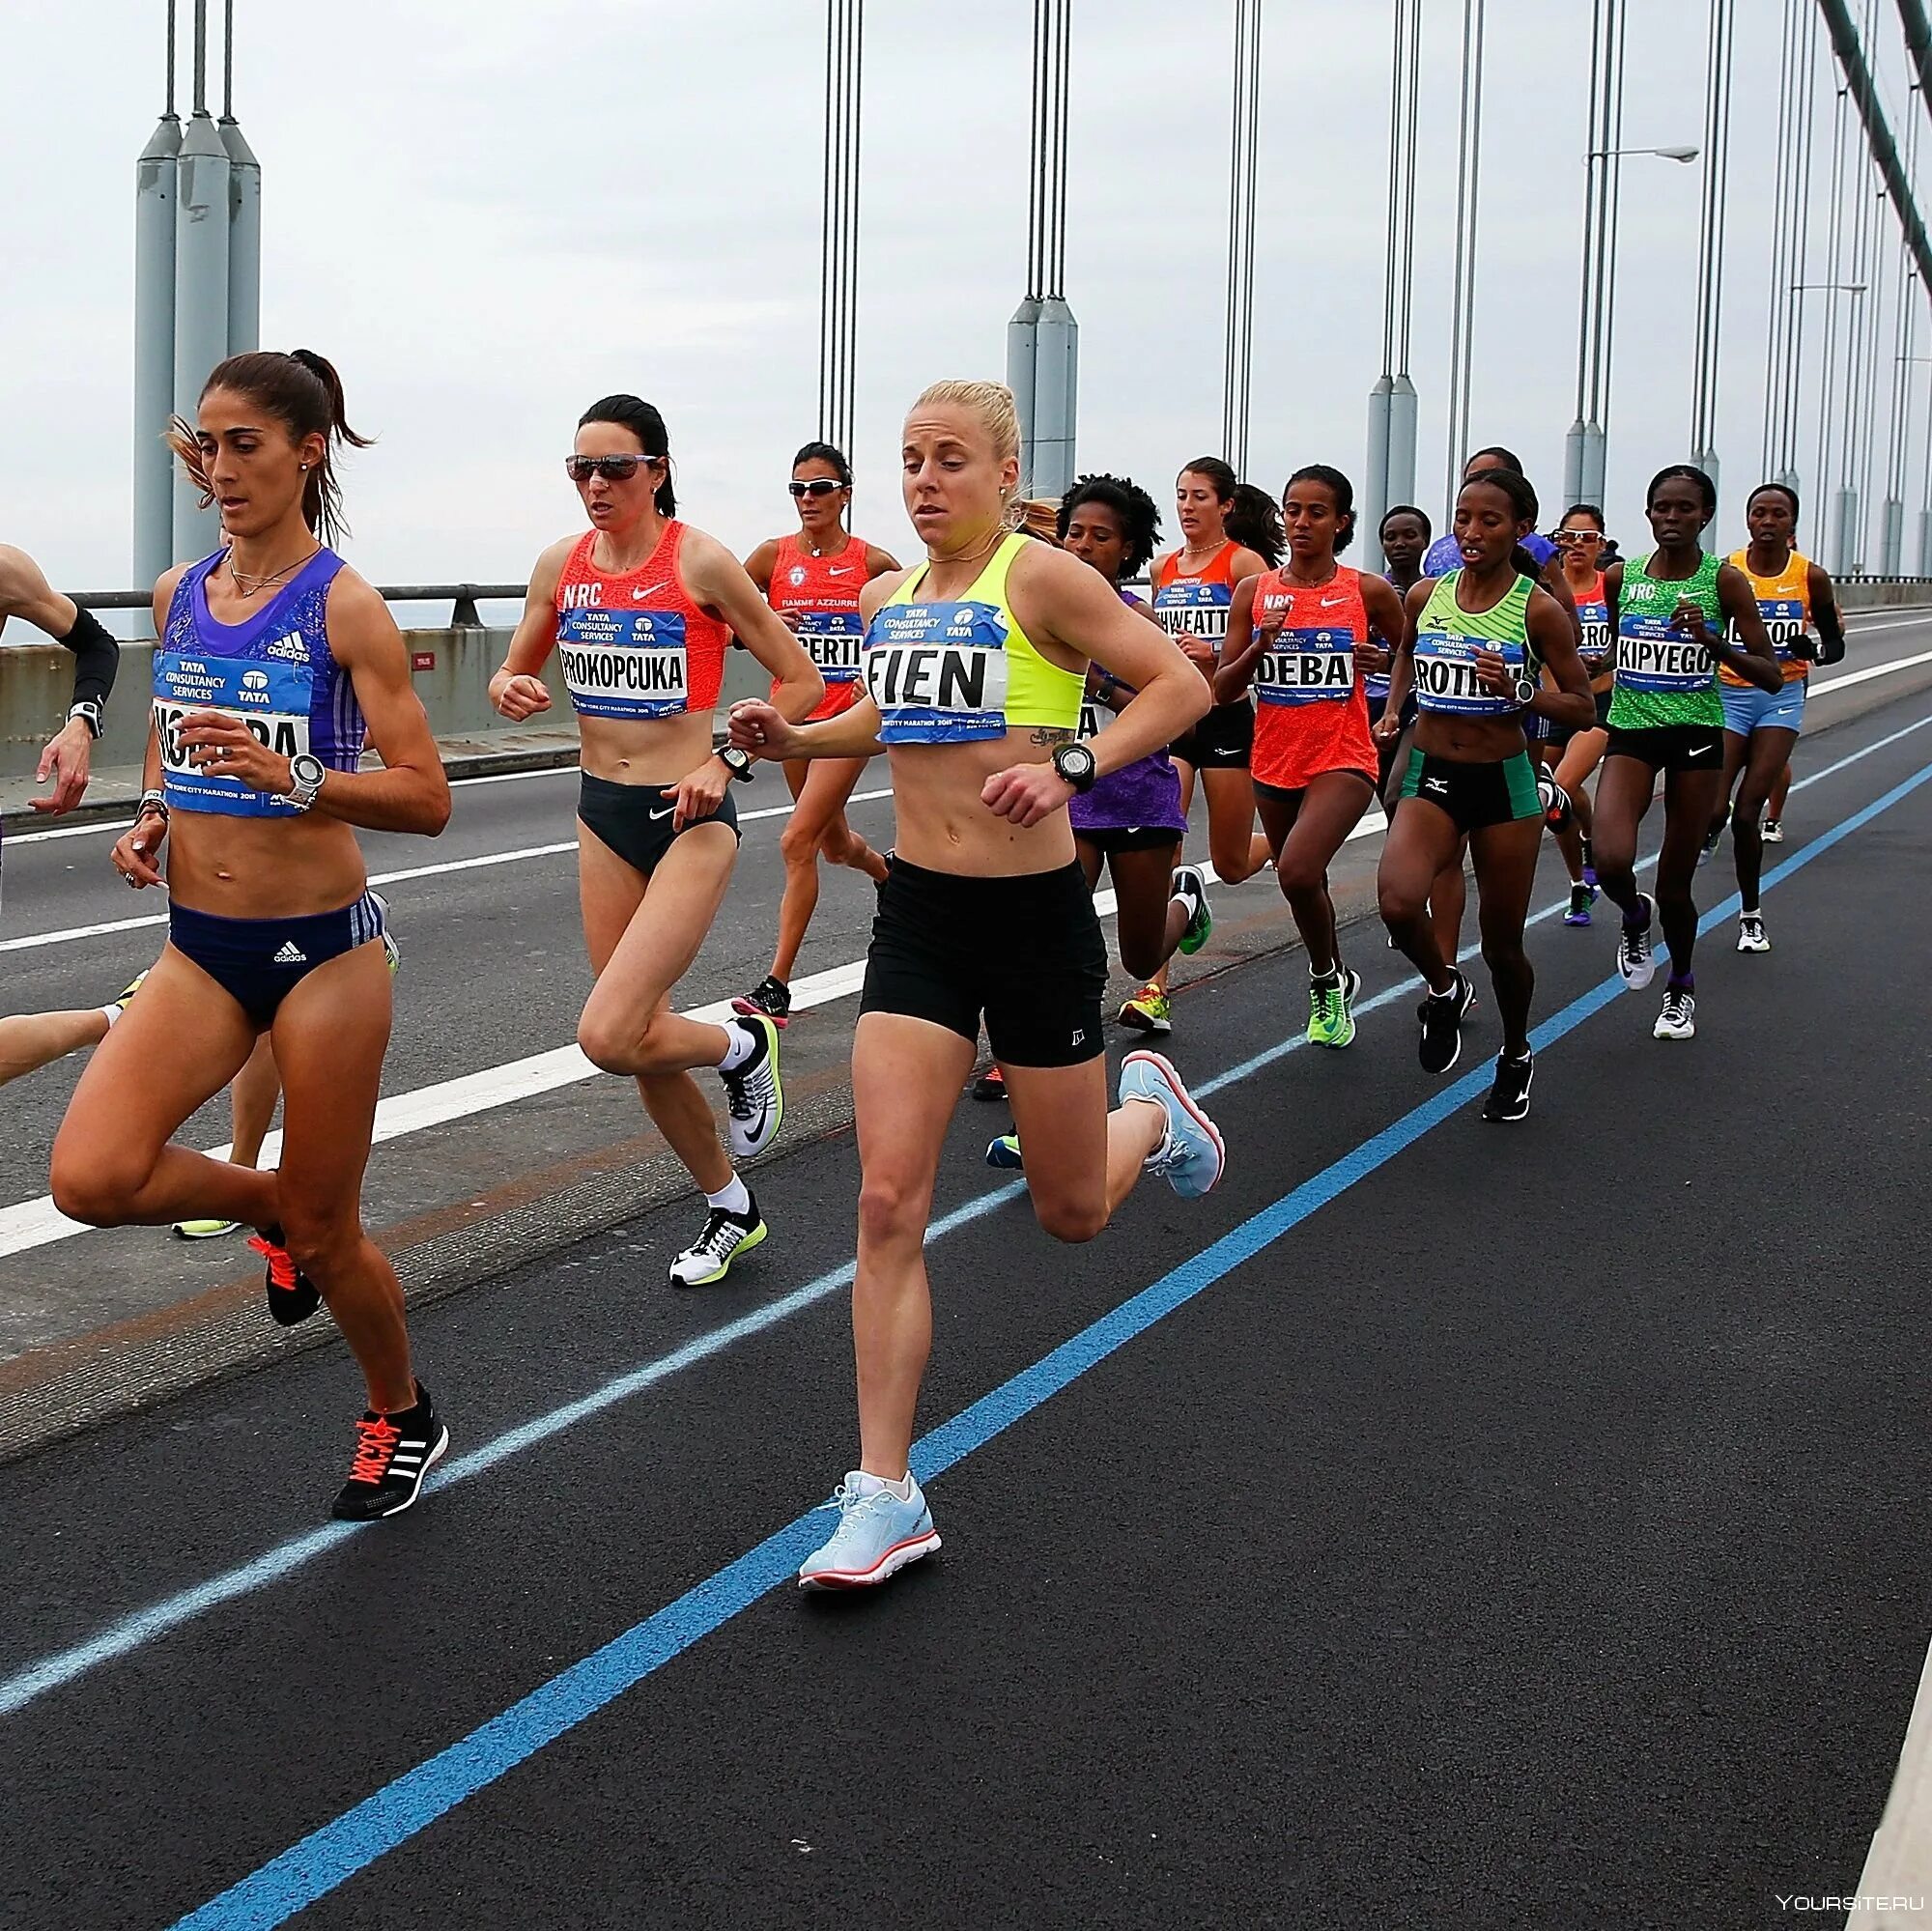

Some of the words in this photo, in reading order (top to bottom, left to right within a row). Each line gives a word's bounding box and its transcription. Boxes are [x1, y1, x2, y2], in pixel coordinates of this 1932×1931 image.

[562, 582, 603, 611] NRC
[1628, 583, 1656, 600] NRC
[1264, 594, 1294, 611] NRC
[585, 613, 610, 622] TATA
[905, 609, 928, 618] TATA
[572, 622, 623, 632] CONSULTANCY
[883, 617, 941, 630] CONSULTANCY
[1158, 610, 1229, 635] HWEATT
[580, 632, 614, 641] SERVICES
[631, 633, 656, 641] TATA
[889, 629, 925, 639] SERVICES
[946, 626, 973, 638] TATA
[1431, 639, 1475, 650] CONSULTANC
[267, 645, 311, 663] adidas
[1436, 647, 1467, 657] SERVICES
[1619, 639, 1713, 674] KIPYEGO
[180, 661, 206, 673] TATA
[560, 649, 684, 690] PROKOPCUKA
[1257, 655, 1350, 686] DEBA
[166, 672, 226, 689] CONSULTANCY
[868, 649, 986, 708] FIEN
[172, 686, 213, 700] SERVICES
[238, 691, 270, 704] TATA
[202, 788, 238, 798] MARATHON
[273, 952, 307, 962] adidas
